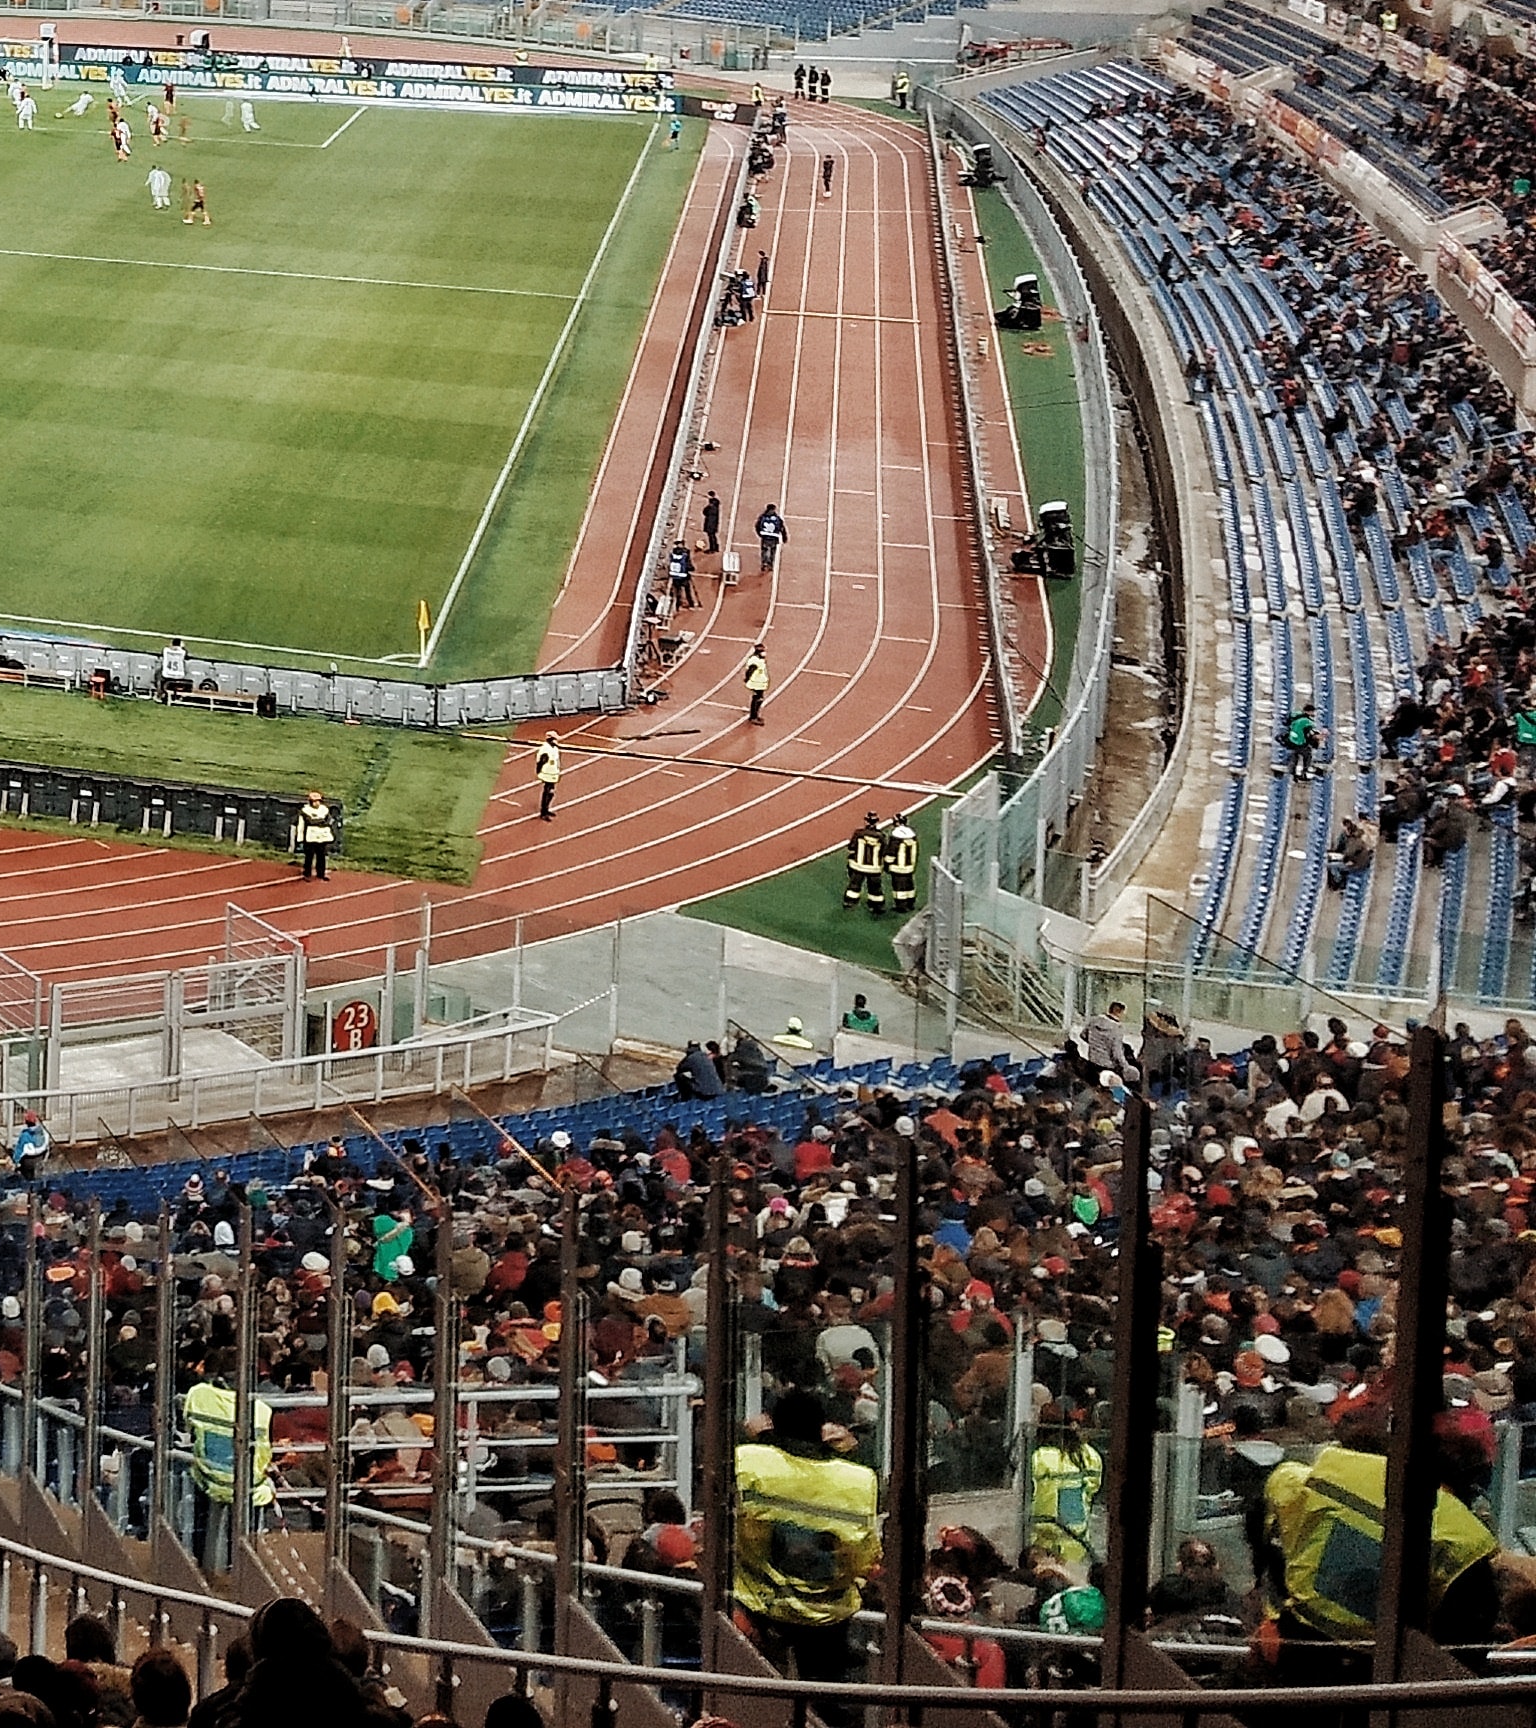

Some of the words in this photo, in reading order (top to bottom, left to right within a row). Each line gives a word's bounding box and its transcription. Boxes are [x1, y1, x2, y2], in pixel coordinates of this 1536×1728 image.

[6, 60, 125, 81] ADMRALYES.it
[137, 68, 263, 89] ADMIRALYES.it
[400, 84, 533, 105] ADMIRALYES.it
[384, 62, 514, 82] ADMIRALYES.it
[343, 1004, 369, 1031] 23
[350, 1028, 362, 1052] B
